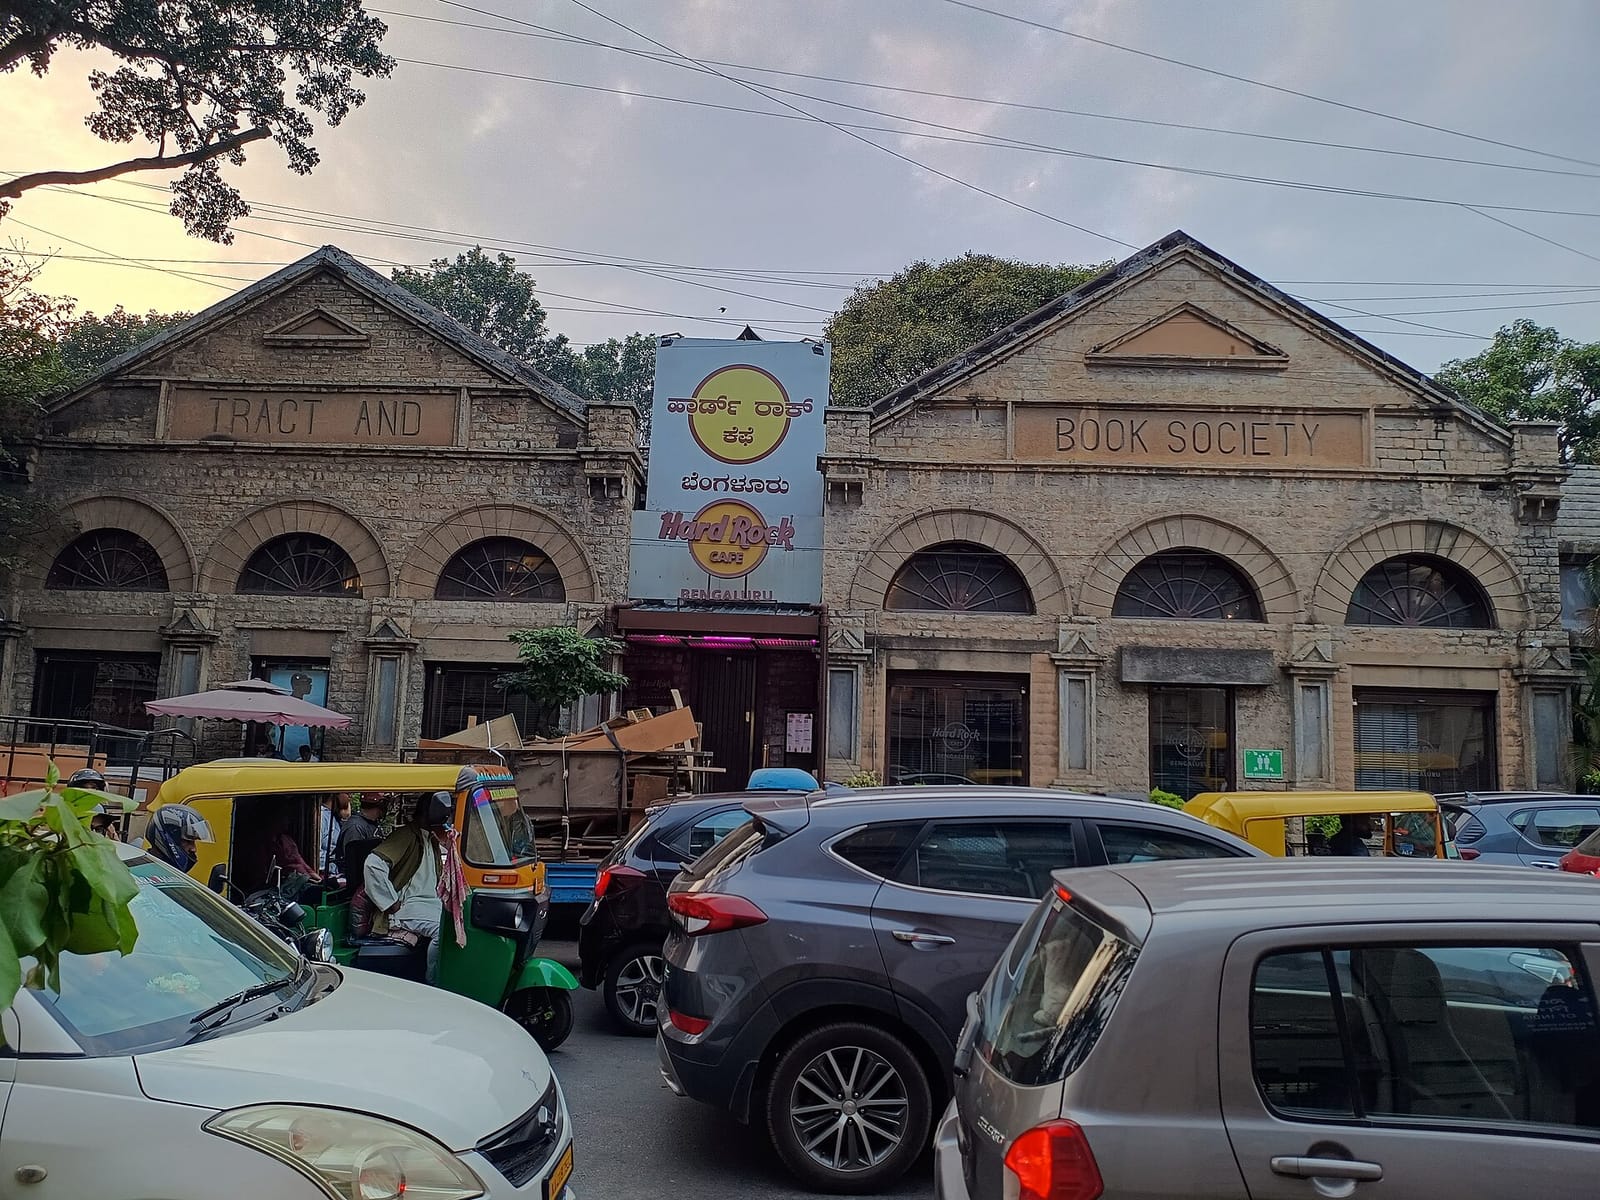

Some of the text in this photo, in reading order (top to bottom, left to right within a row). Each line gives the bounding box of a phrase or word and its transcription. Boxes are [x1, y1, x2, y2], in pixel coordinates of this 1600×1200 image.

[209, 397, 422, 437] TRACT AND
[754, 398, 813, 417] ರಾಕ್
[1055, 417, 1321, 457] BOOK SOCIETY
[681, 472, 790, 494] ಬೆಂಗಳೂರು
[658, 512, 795, 551] Hard Rock
[709, 550, 744, 564] CAFE
[680, 588, 773, 600] BENGALURU
